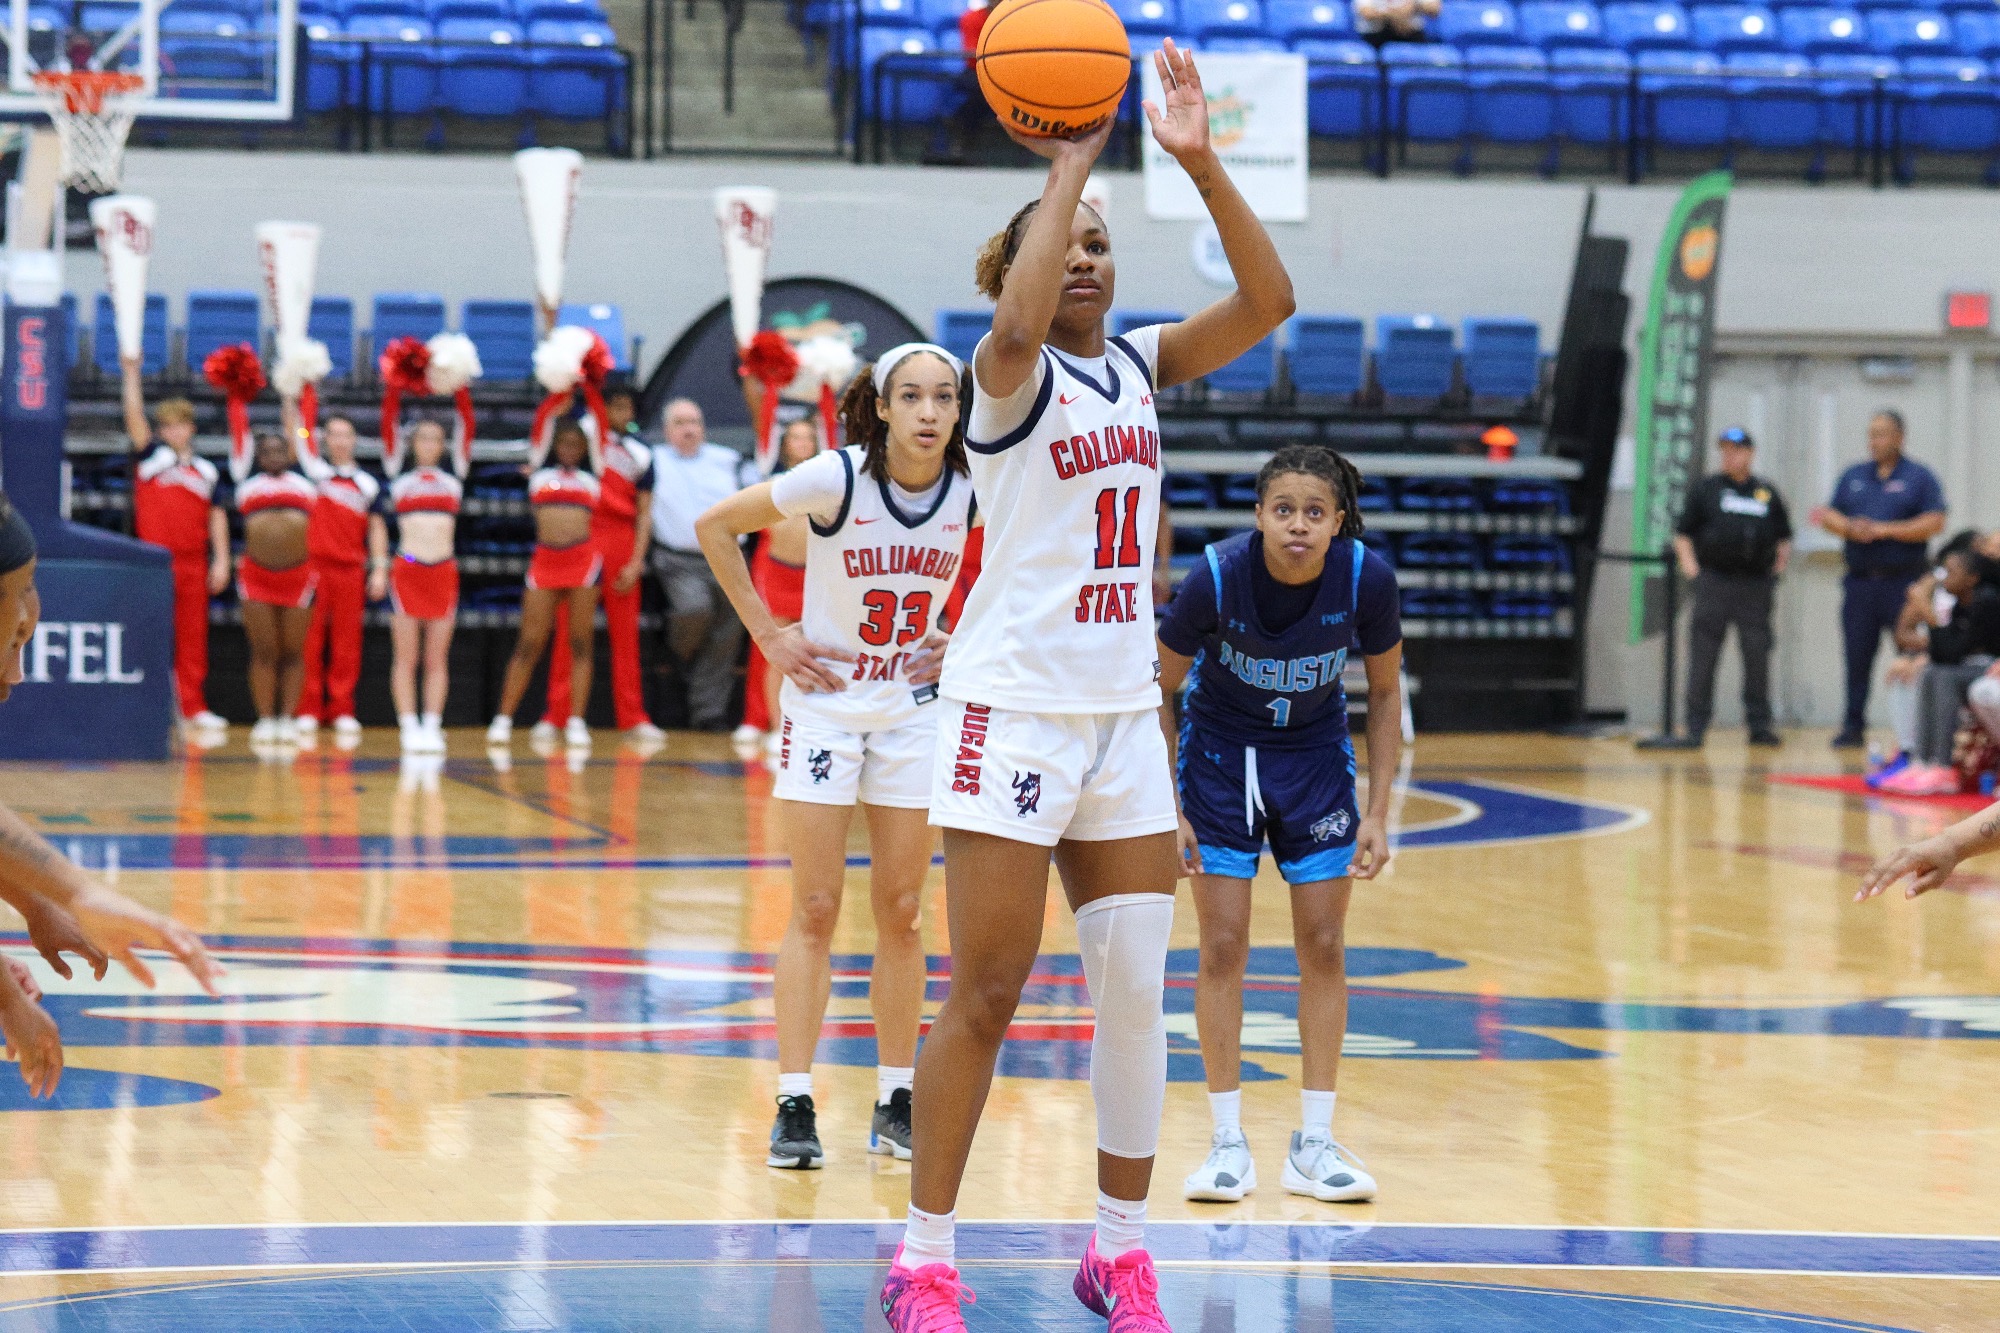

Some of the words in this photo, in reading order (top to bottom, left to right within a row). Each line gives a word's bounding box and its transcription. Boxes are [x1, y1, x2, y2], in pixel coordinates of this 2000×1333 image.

[18, 317, 46, 411] CSU
[1049, 425, 1159, 480] COLUMBU
[1094, 486, 1141, 570] 11
[859, 588, 932, 647] 33
[20, 621, 145, 684] FEL
[1219, 640, 1348, 693] AUGUSTA
[1265, 696, 1292, 727] 1
[952, 702, 992, 797] OUGARS
